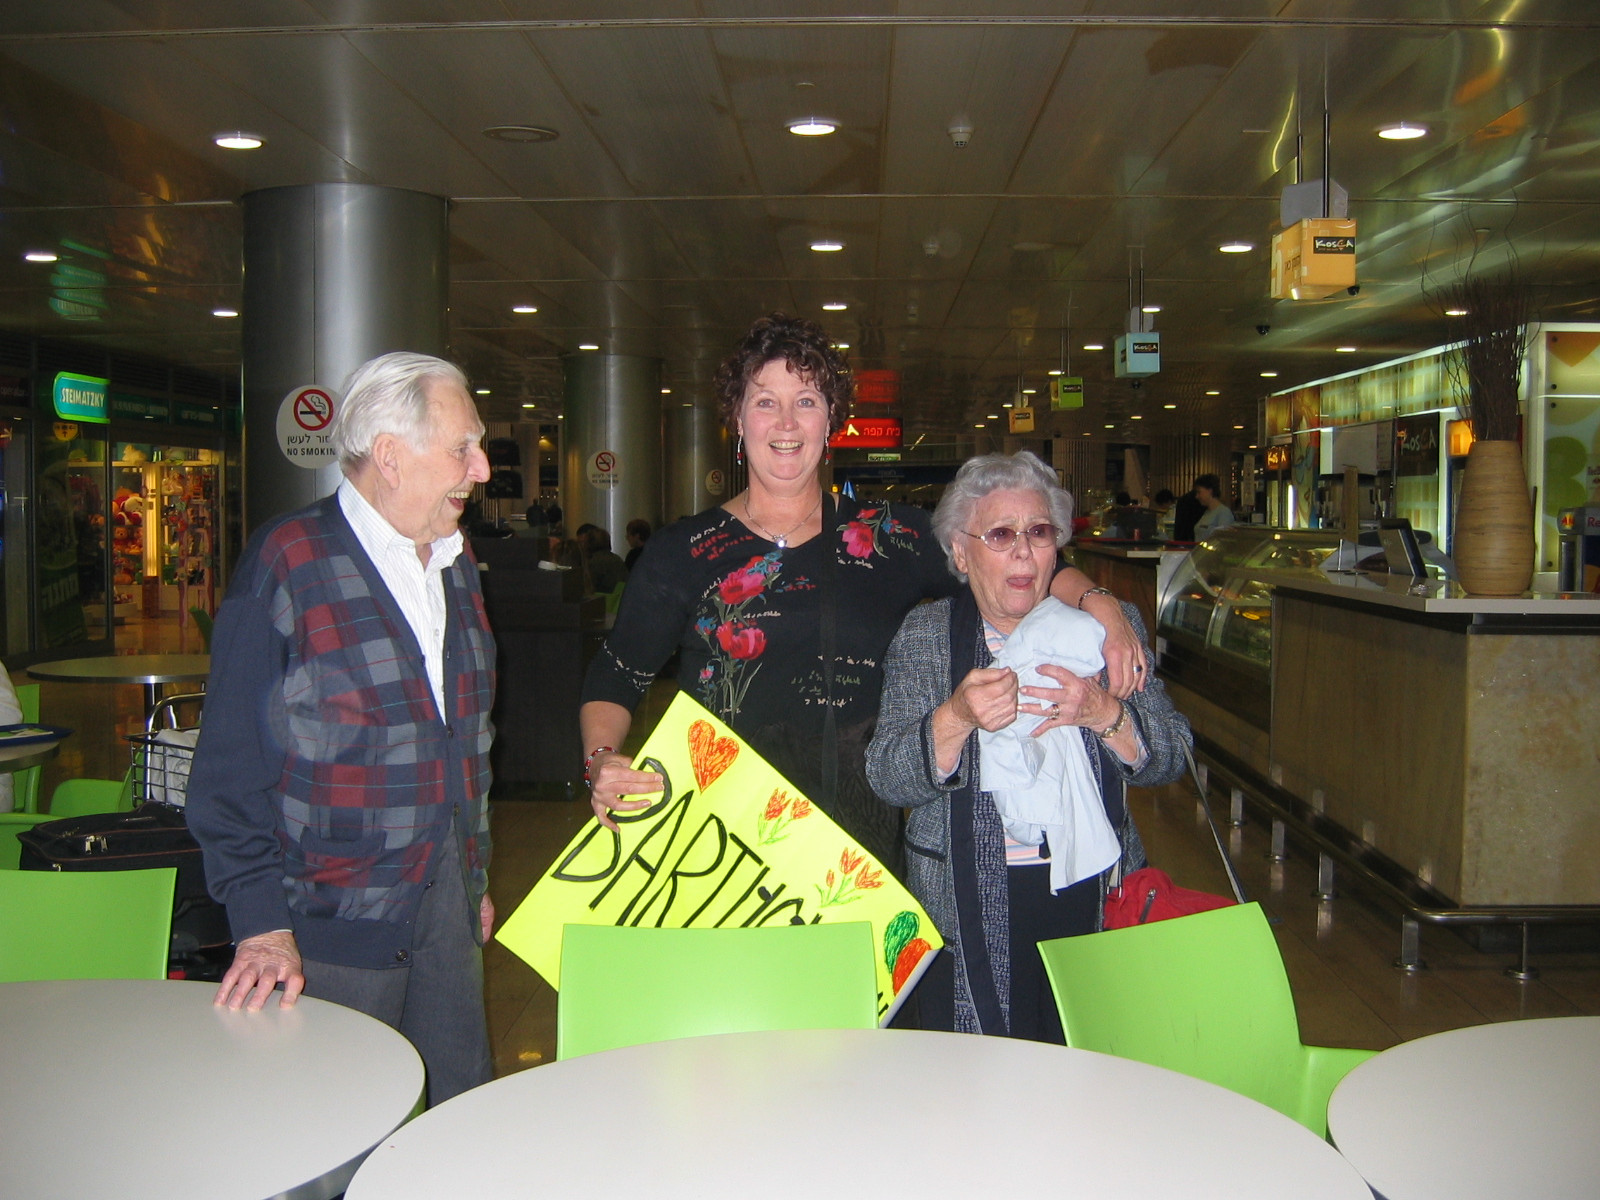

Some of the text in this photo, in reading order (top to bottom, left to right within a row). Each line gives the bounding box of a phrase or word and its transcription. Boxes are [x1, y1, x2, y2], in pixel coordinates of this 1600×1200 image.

[61, 387, 105, 407] STEIMATZKY
[287, 433, 311, 445] לעשן
[286, 448, 336, 456] NO SMOKIN
